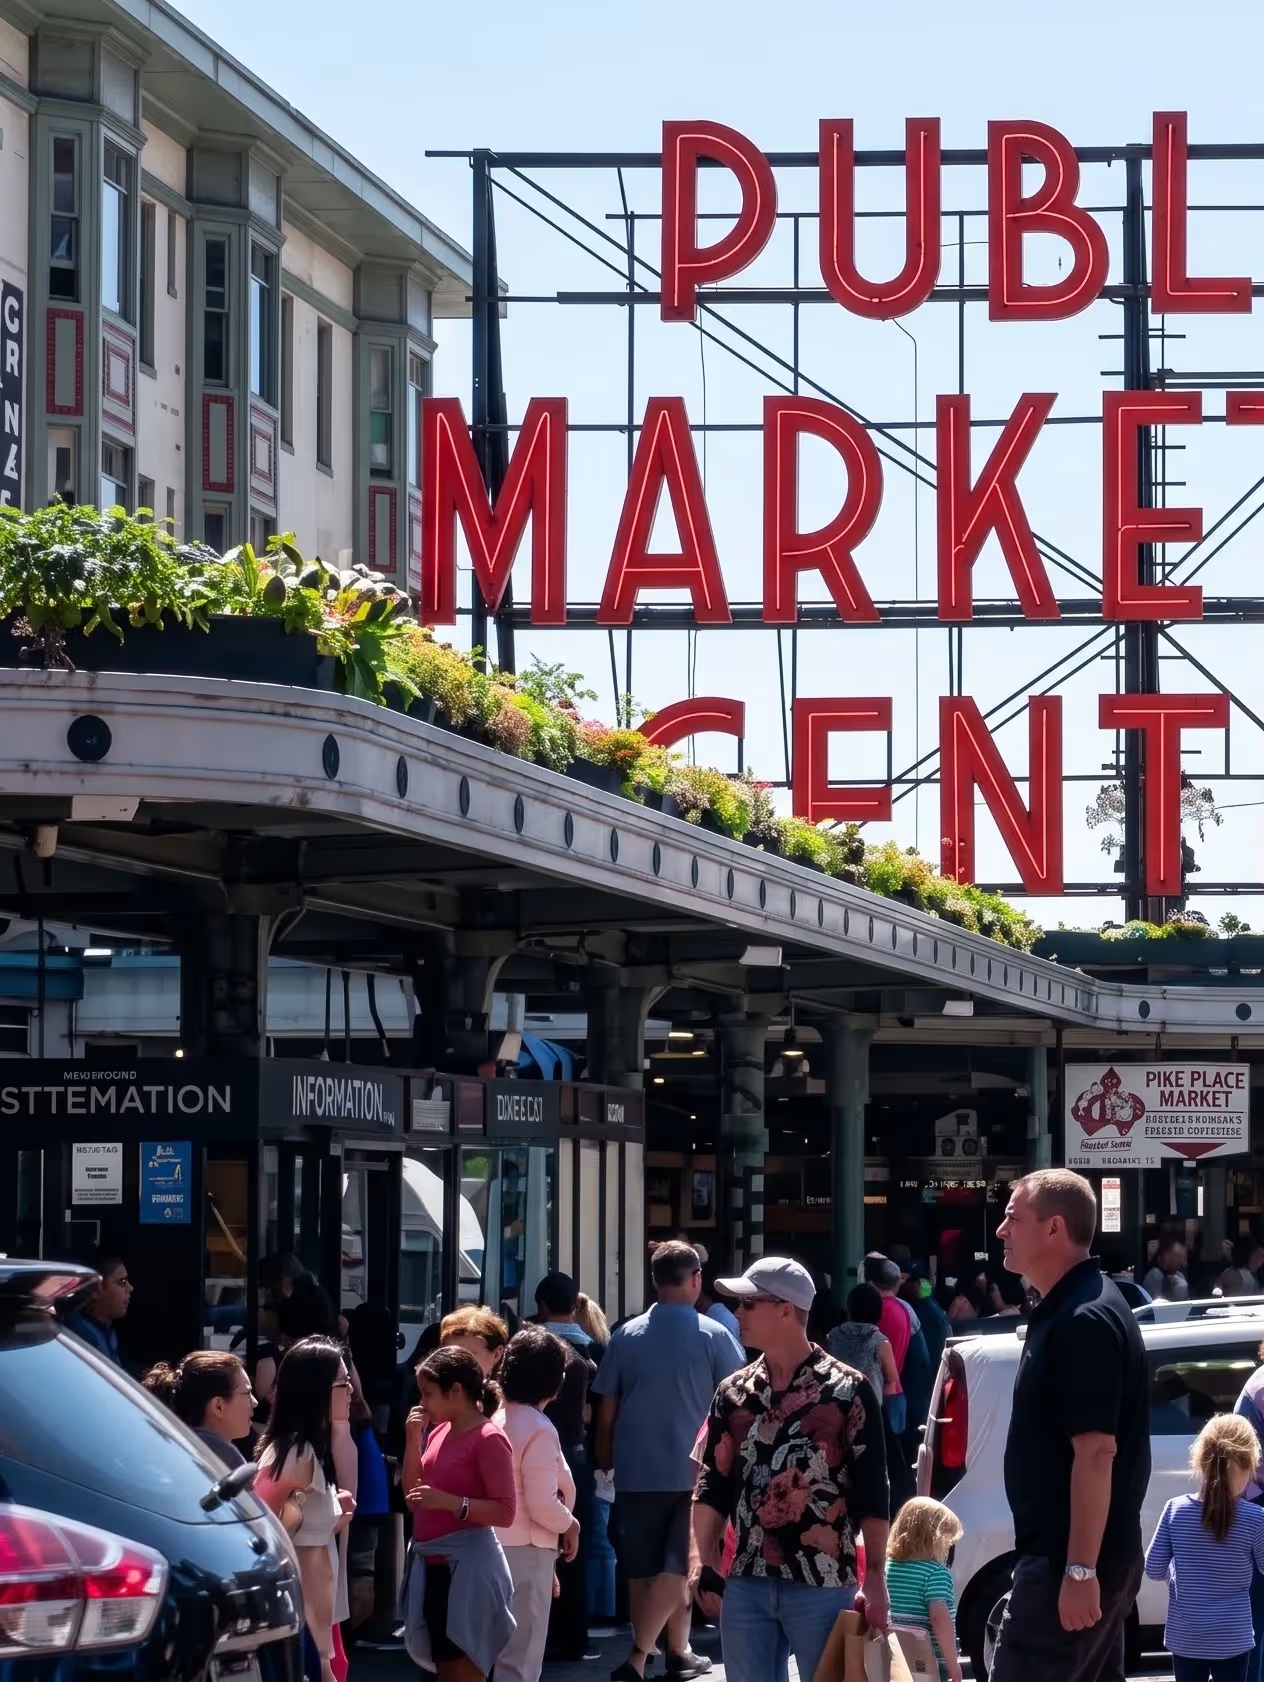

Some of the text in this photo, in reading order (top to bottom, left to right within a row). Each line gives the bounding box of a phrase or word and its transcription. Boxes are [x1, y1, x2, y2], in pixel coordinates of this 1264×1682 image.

[1145, 1070, 1246, 1089] PIKE PLACE
[0, 1084, 231, 1115] STTEMATION
[292, 1075, 383, 1122] INFORMATION
[1159, 1090, 1233, 1109] MARKET
